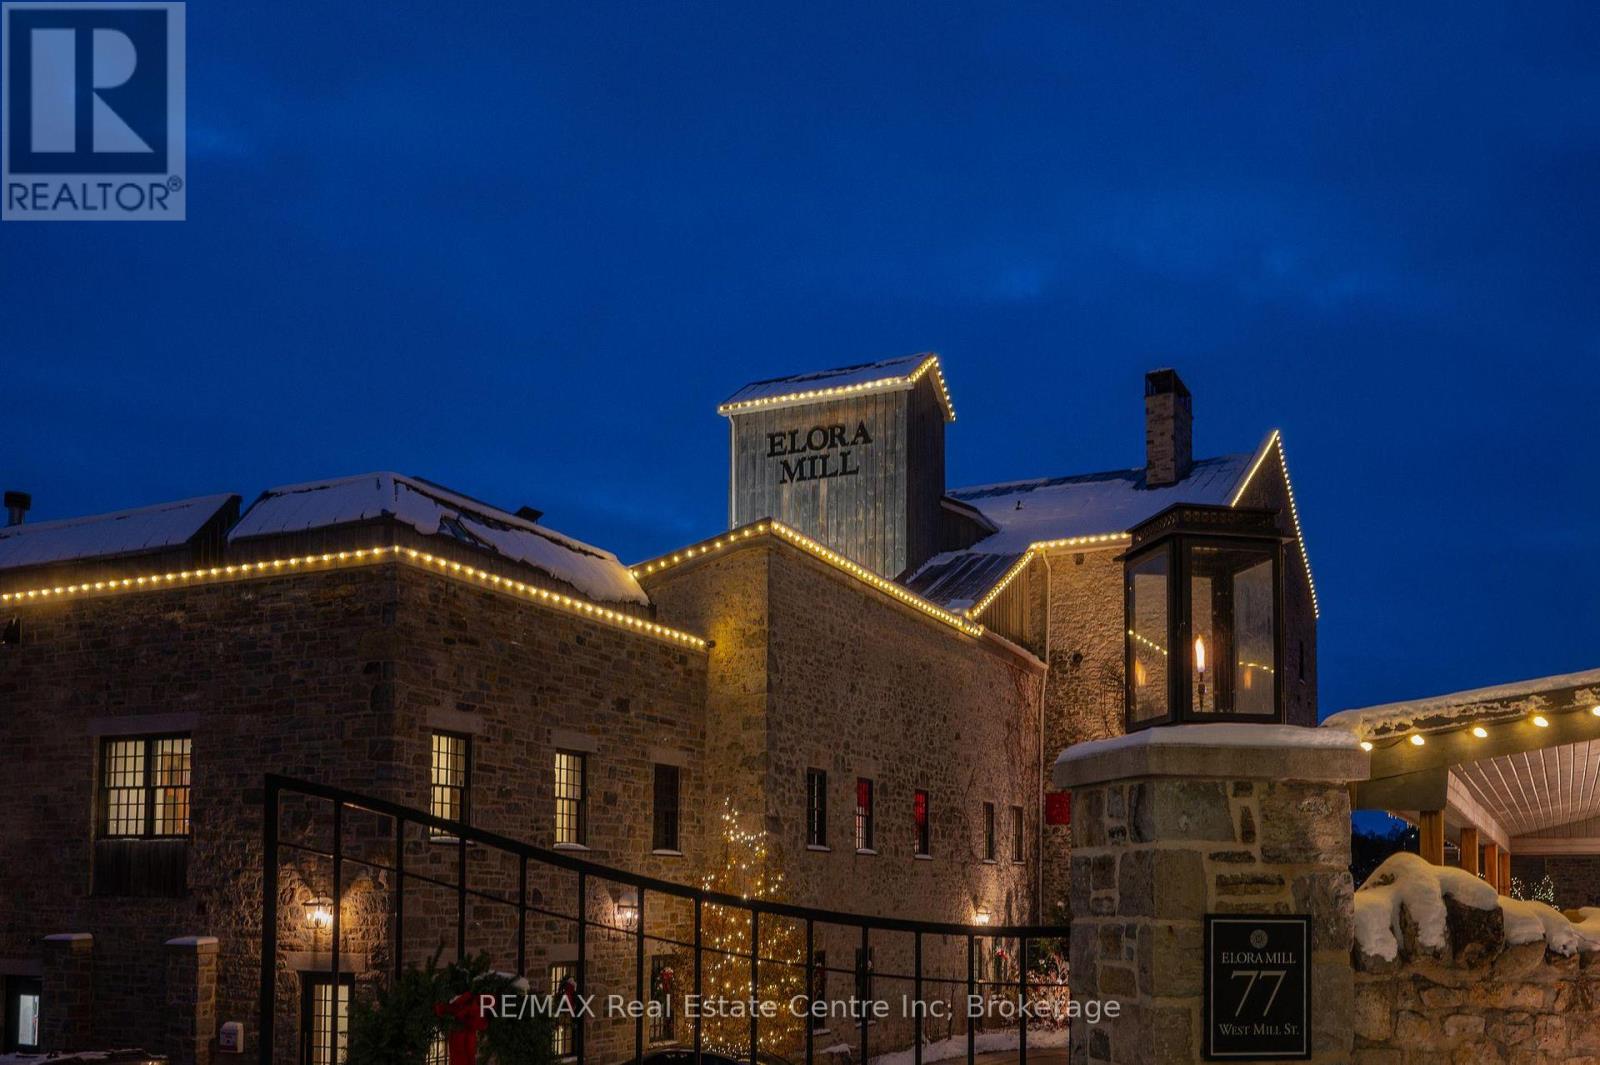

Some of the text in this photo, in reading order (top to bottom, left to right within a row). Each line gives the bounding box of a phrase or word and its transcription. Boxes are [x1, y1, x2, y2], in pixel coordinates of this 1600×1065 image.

[767, 420, 873, 458] ELORA
[780, 450, 860, 484] MILL
[1221, 951, 1297, 965] ELORA MILL
[1230, 970, 1287, 1017] 77
